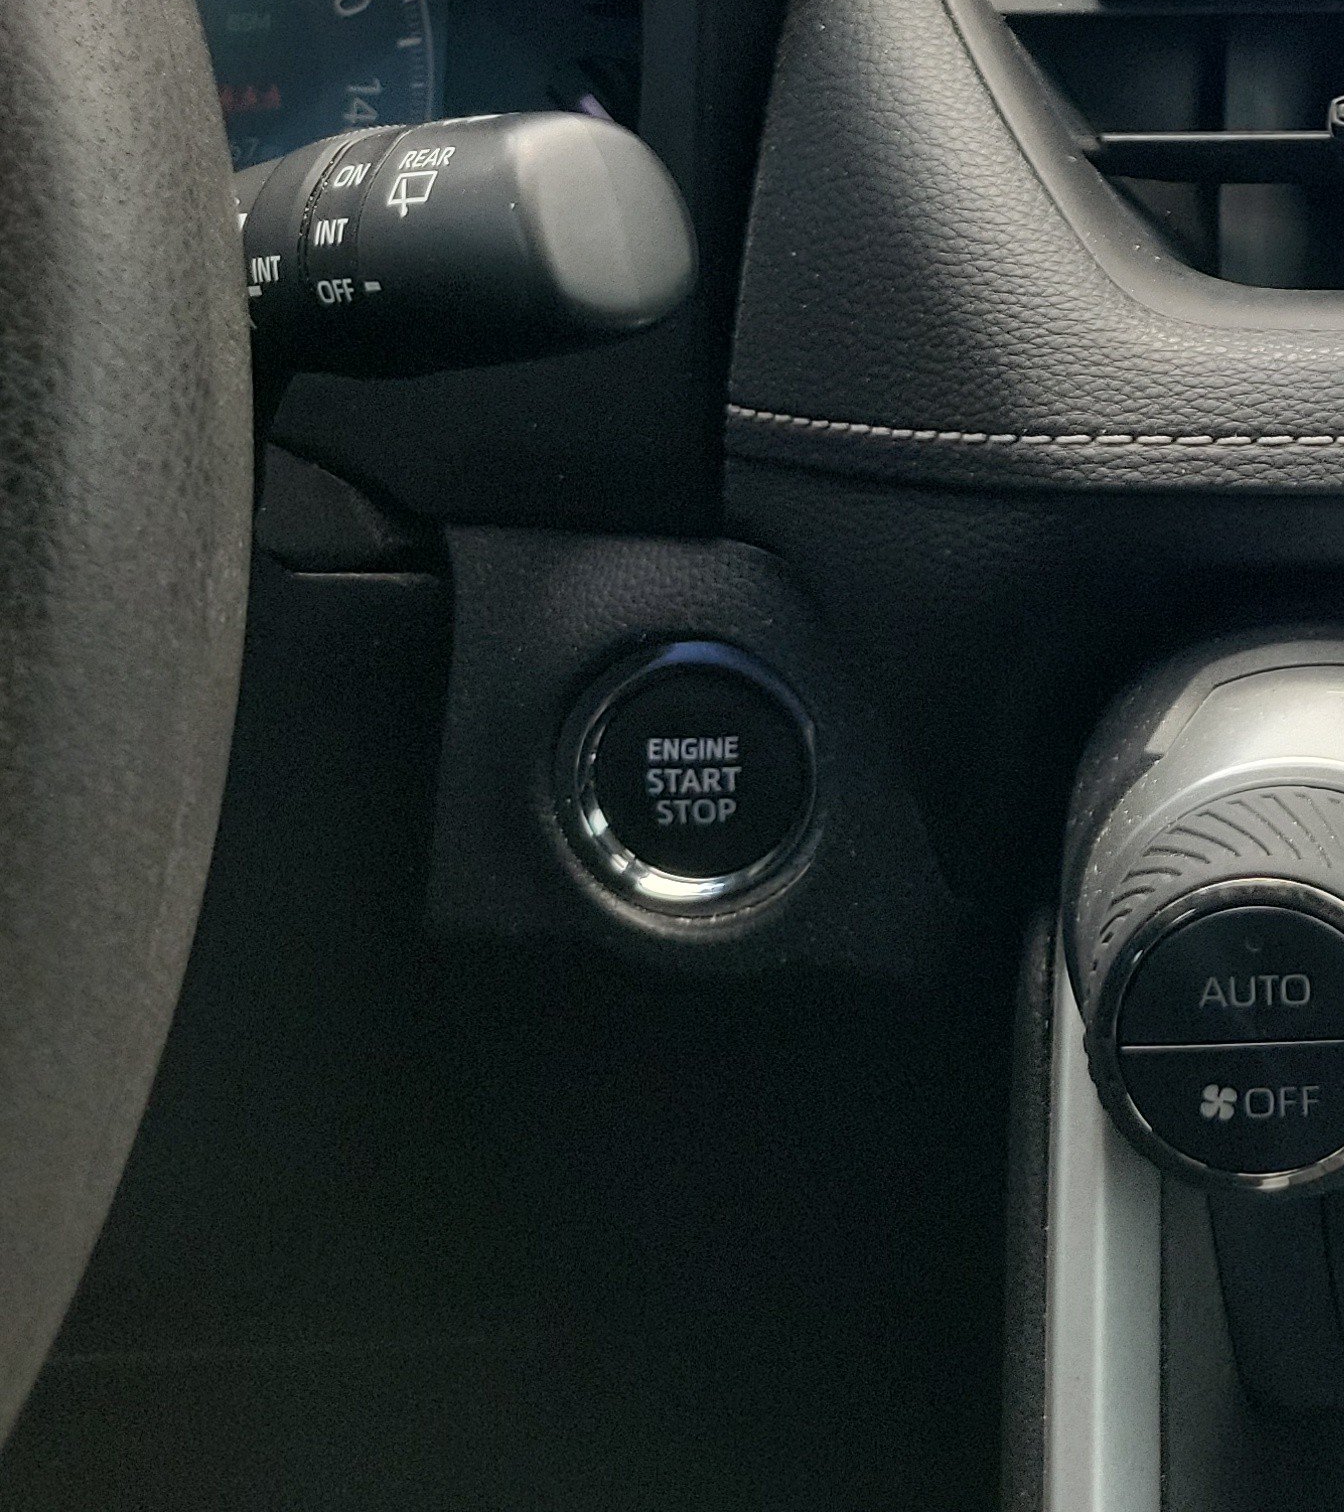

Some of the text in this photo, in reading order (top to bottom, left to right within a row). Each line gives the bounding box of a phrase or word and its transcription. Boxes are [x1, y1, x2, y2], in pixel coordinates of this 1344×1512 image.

[347, 77, 382, 124] 14
[397, 146, 456, 170] REAR
[332, 163, 371, 189] ON
[314, 217, 349, 245] INT
[251, 255, 281, 282] INT
[316, 277, 354, 304] OFF
[647, 737, 739, 761] ENGINE
[646, 766, 741, 794] START
[656, 798, 737, 825] STOP
[1199, 973, 1311, 1008] AUTO
[1243, 1085, 1320, 1119] OFF
